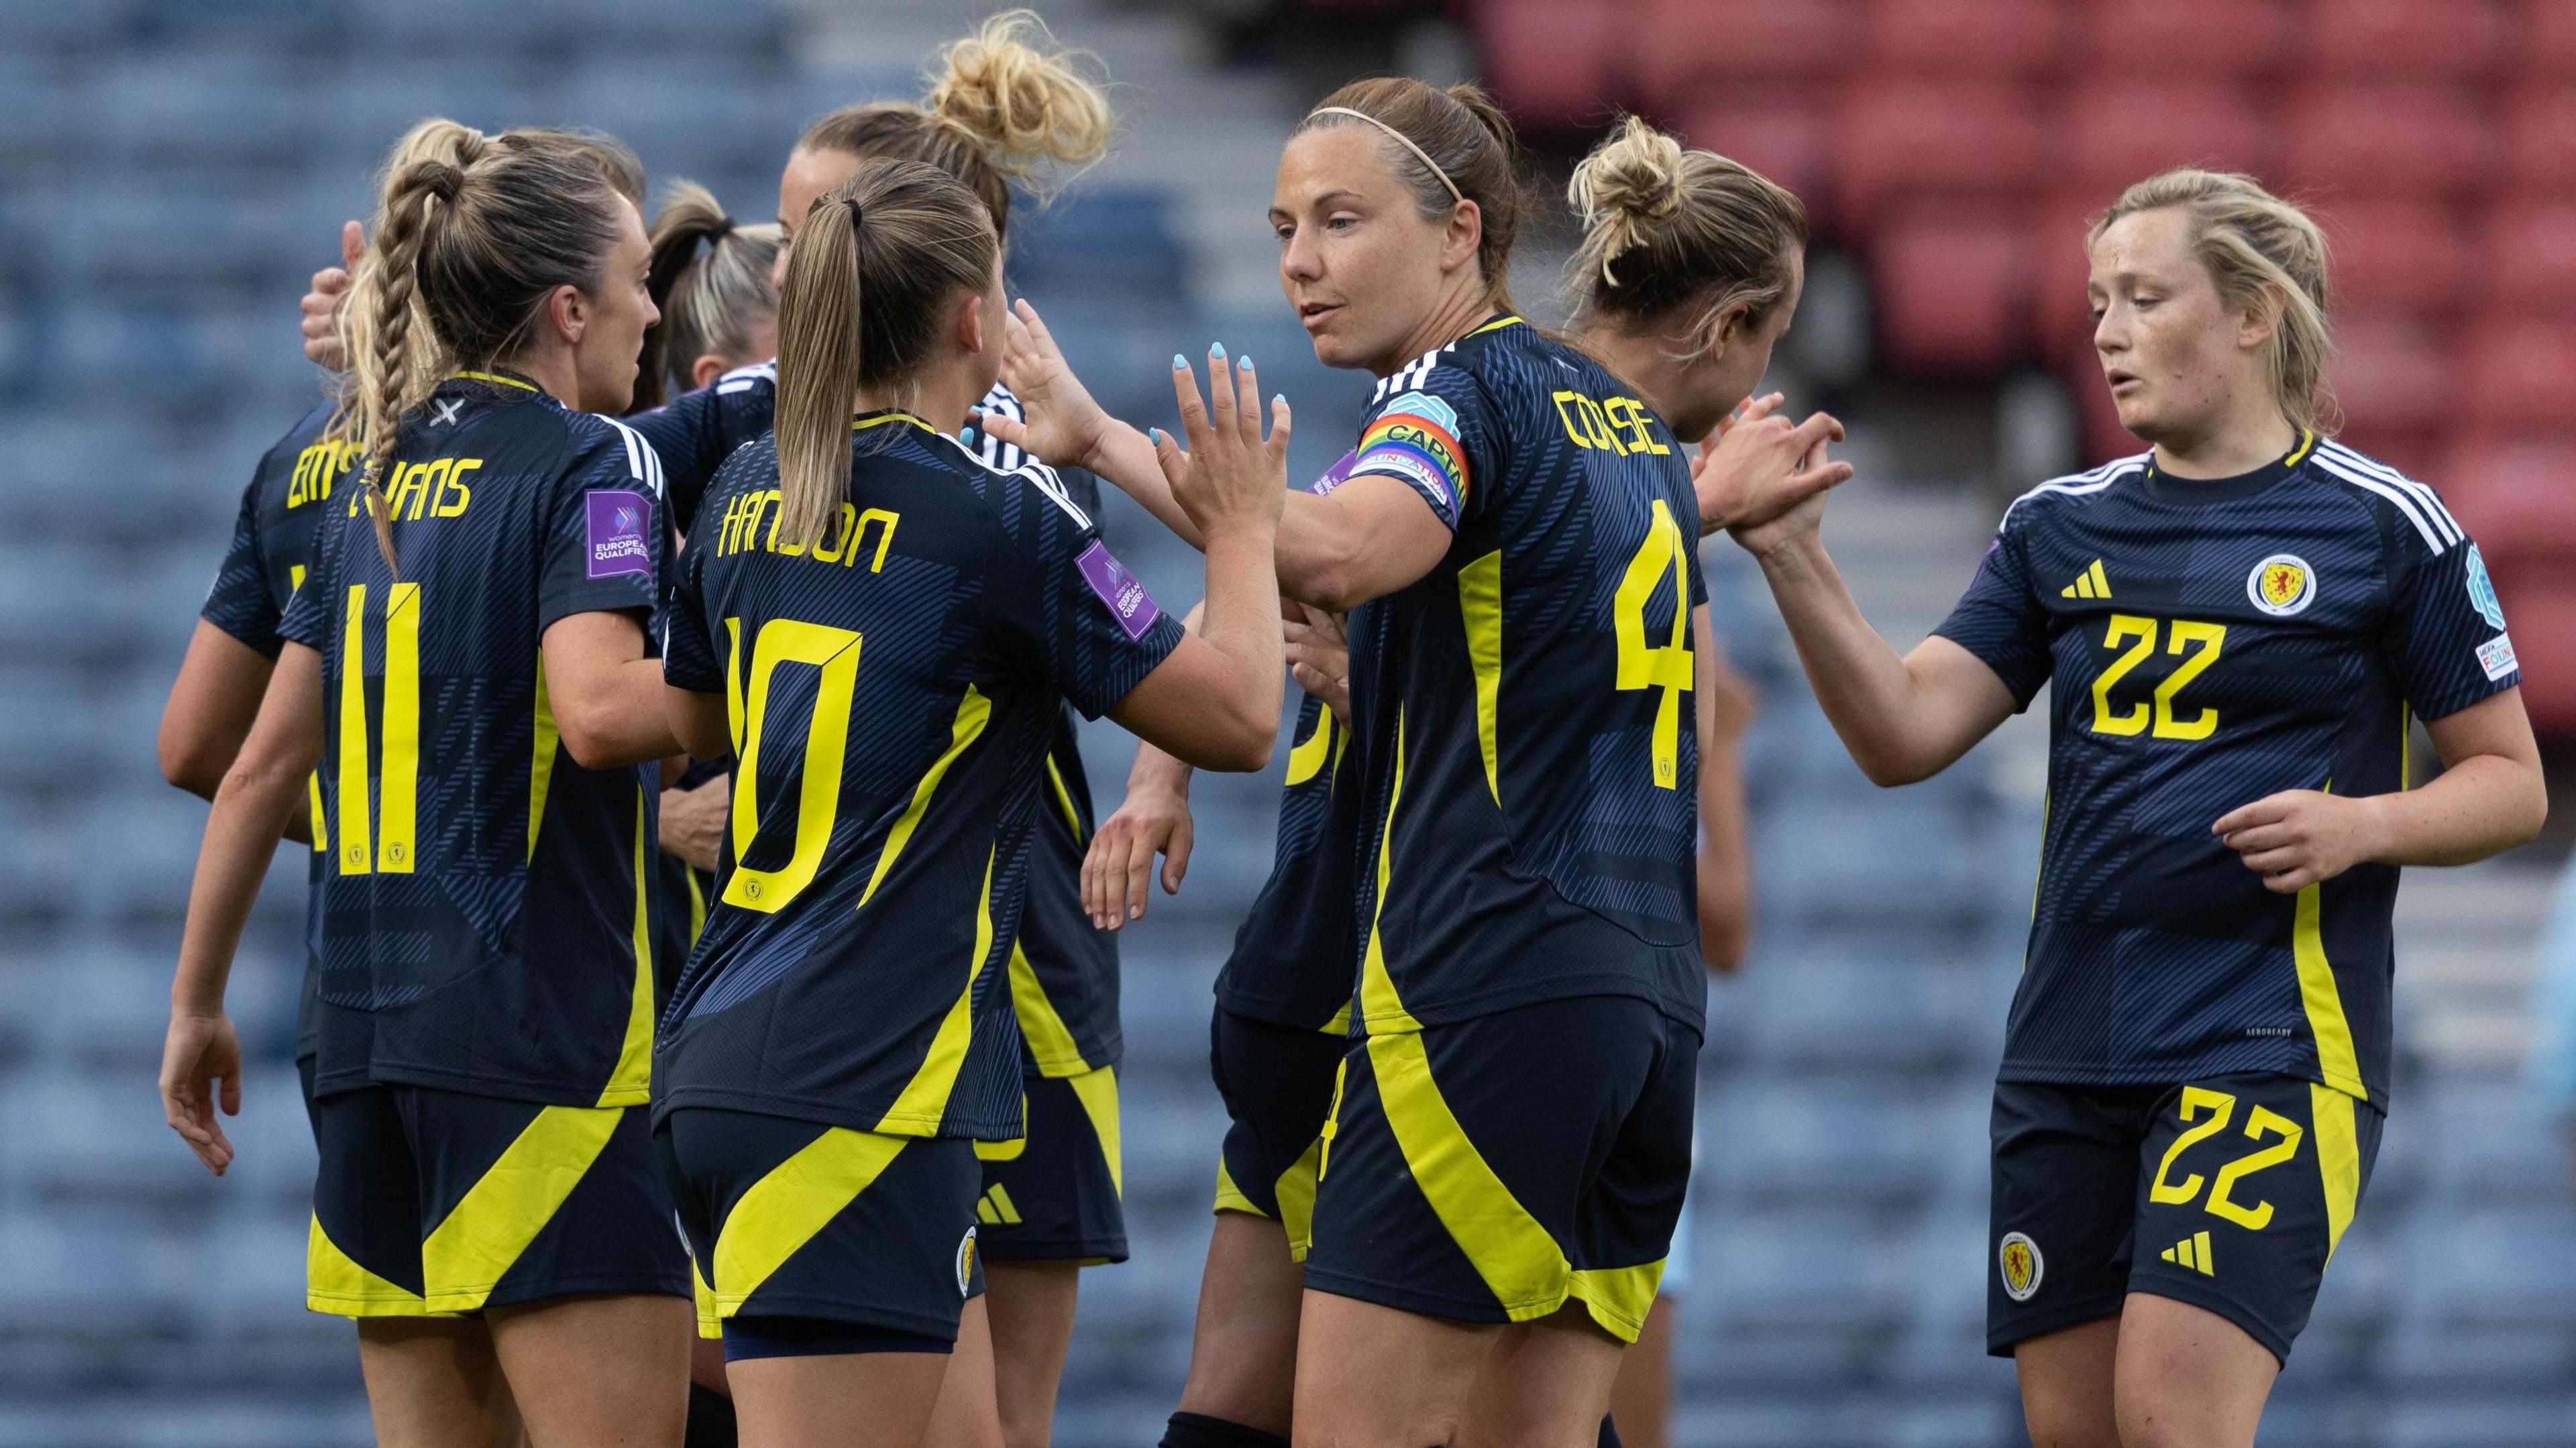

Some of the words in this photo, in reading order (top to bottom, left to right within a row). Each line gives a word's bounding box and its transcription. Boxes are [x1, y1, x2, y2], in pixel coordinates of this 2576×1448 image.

[717, 490, 900, 573] HANON
[1613, 499, 1694, 790] 4
[2090, 614, 2226, 740] 22
[338, 582, 421, 875] 11
[722, 617, 863, 913] 10
[2246, 1027, 2292, 1037] AEROREADY
[2149, 1085, 2304, 1231] 22
